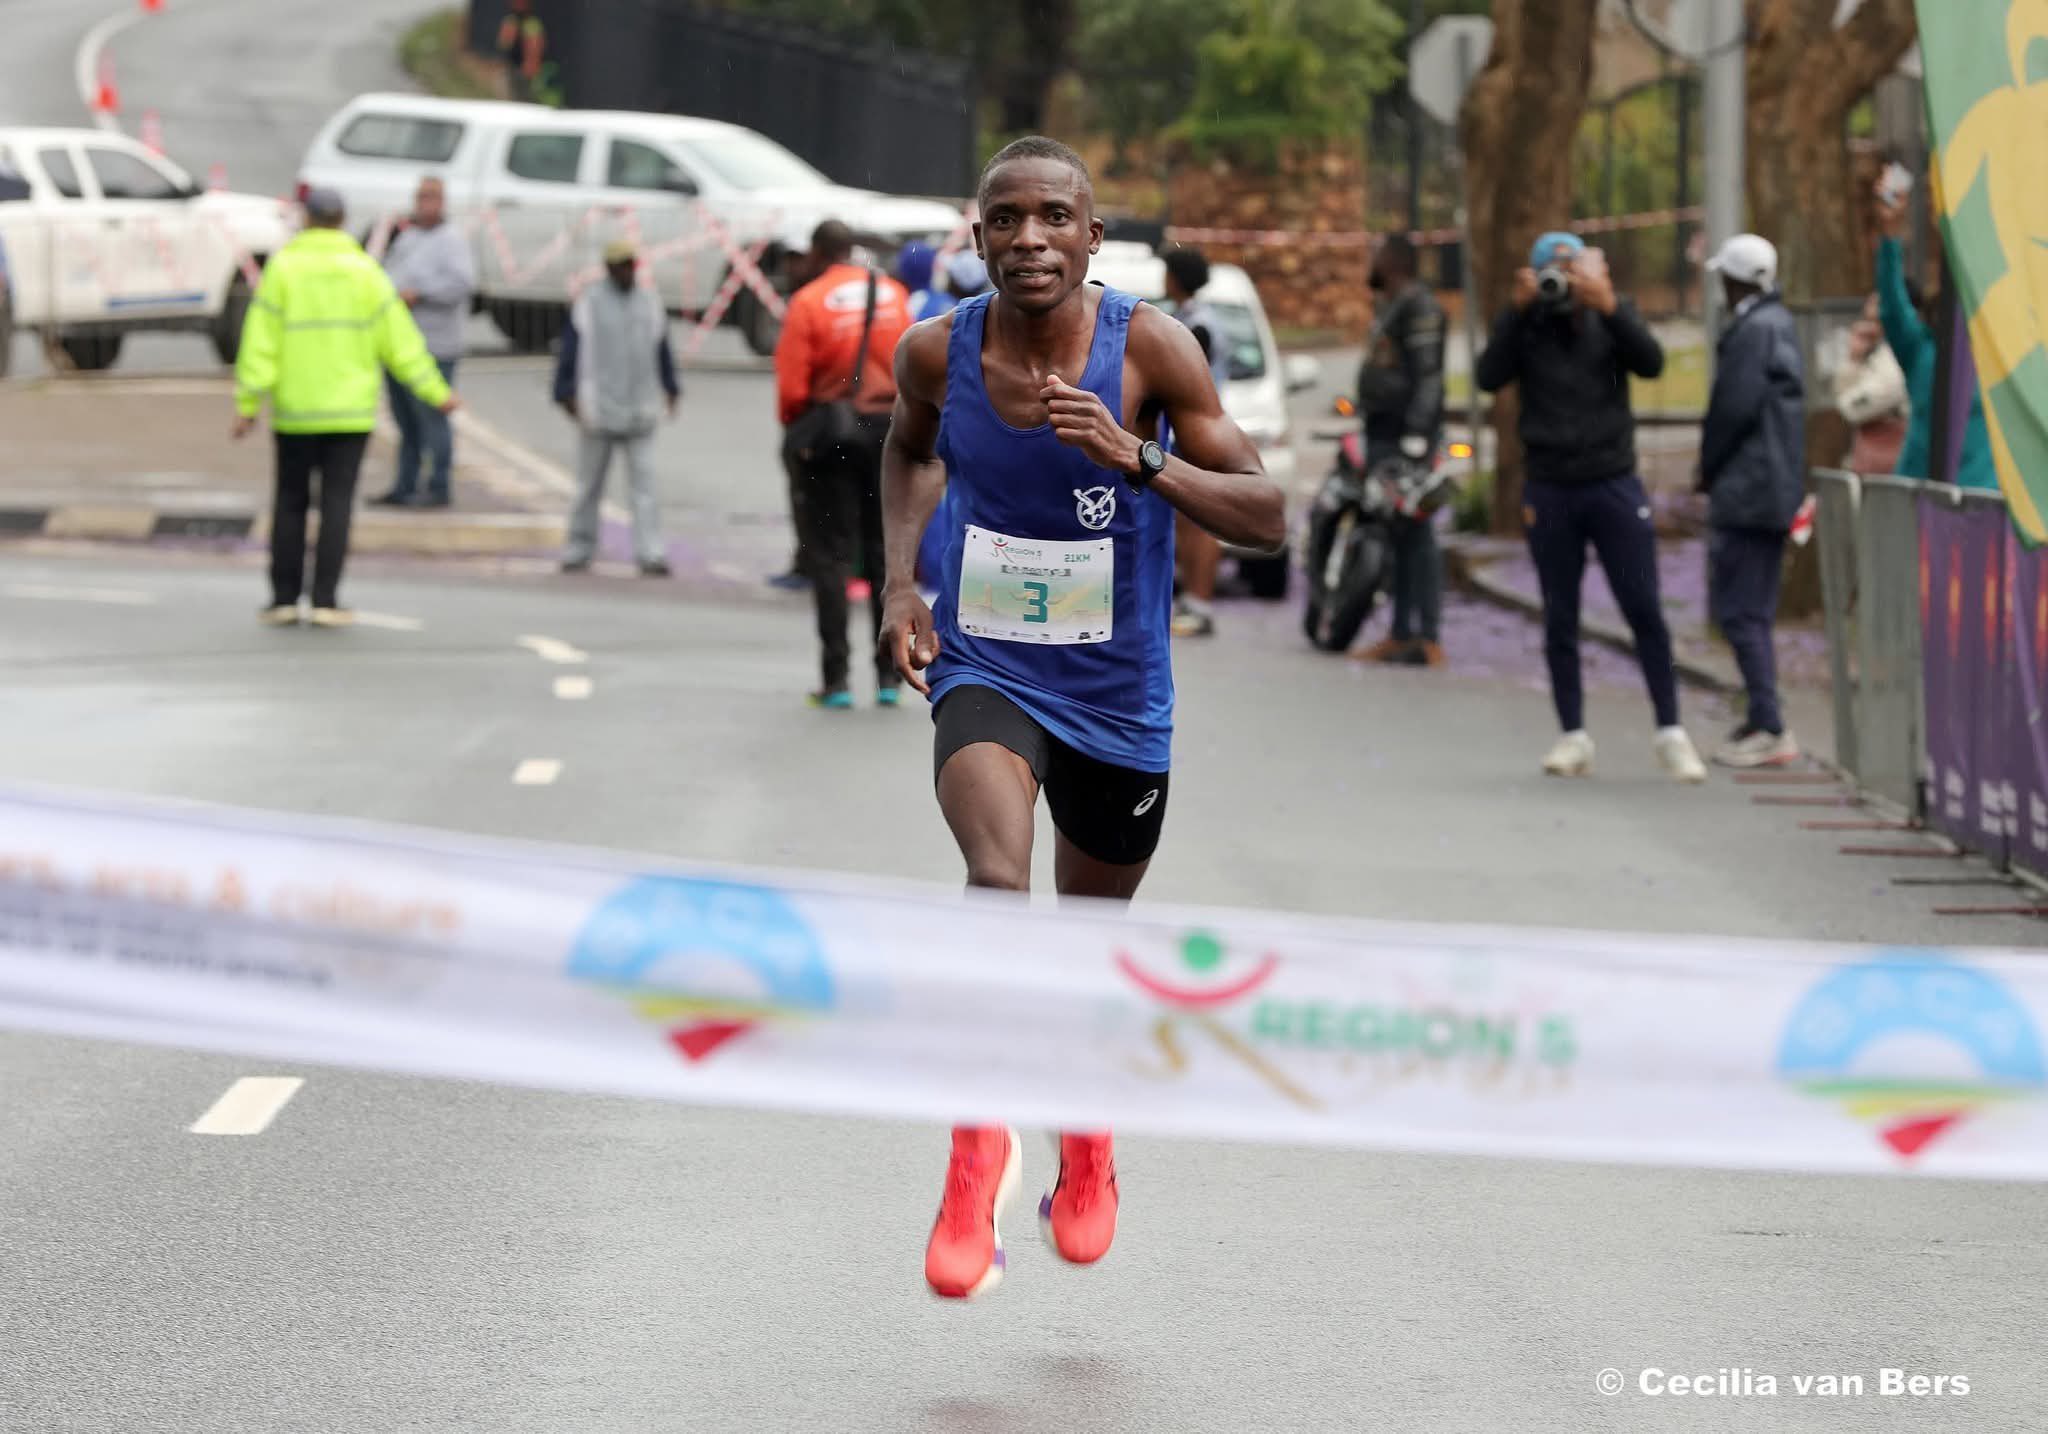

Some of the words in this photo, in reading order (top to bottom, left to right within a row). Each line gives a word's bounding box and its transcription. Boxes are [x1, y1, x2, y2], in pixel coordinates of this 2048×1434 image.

[1064, 553, 1091, 563] 21KM
[1023, 581, 1049, 624] 3
[1249, 996, 1520, 1061] REGION
[1537, 1012, 1580, 1068] 5
